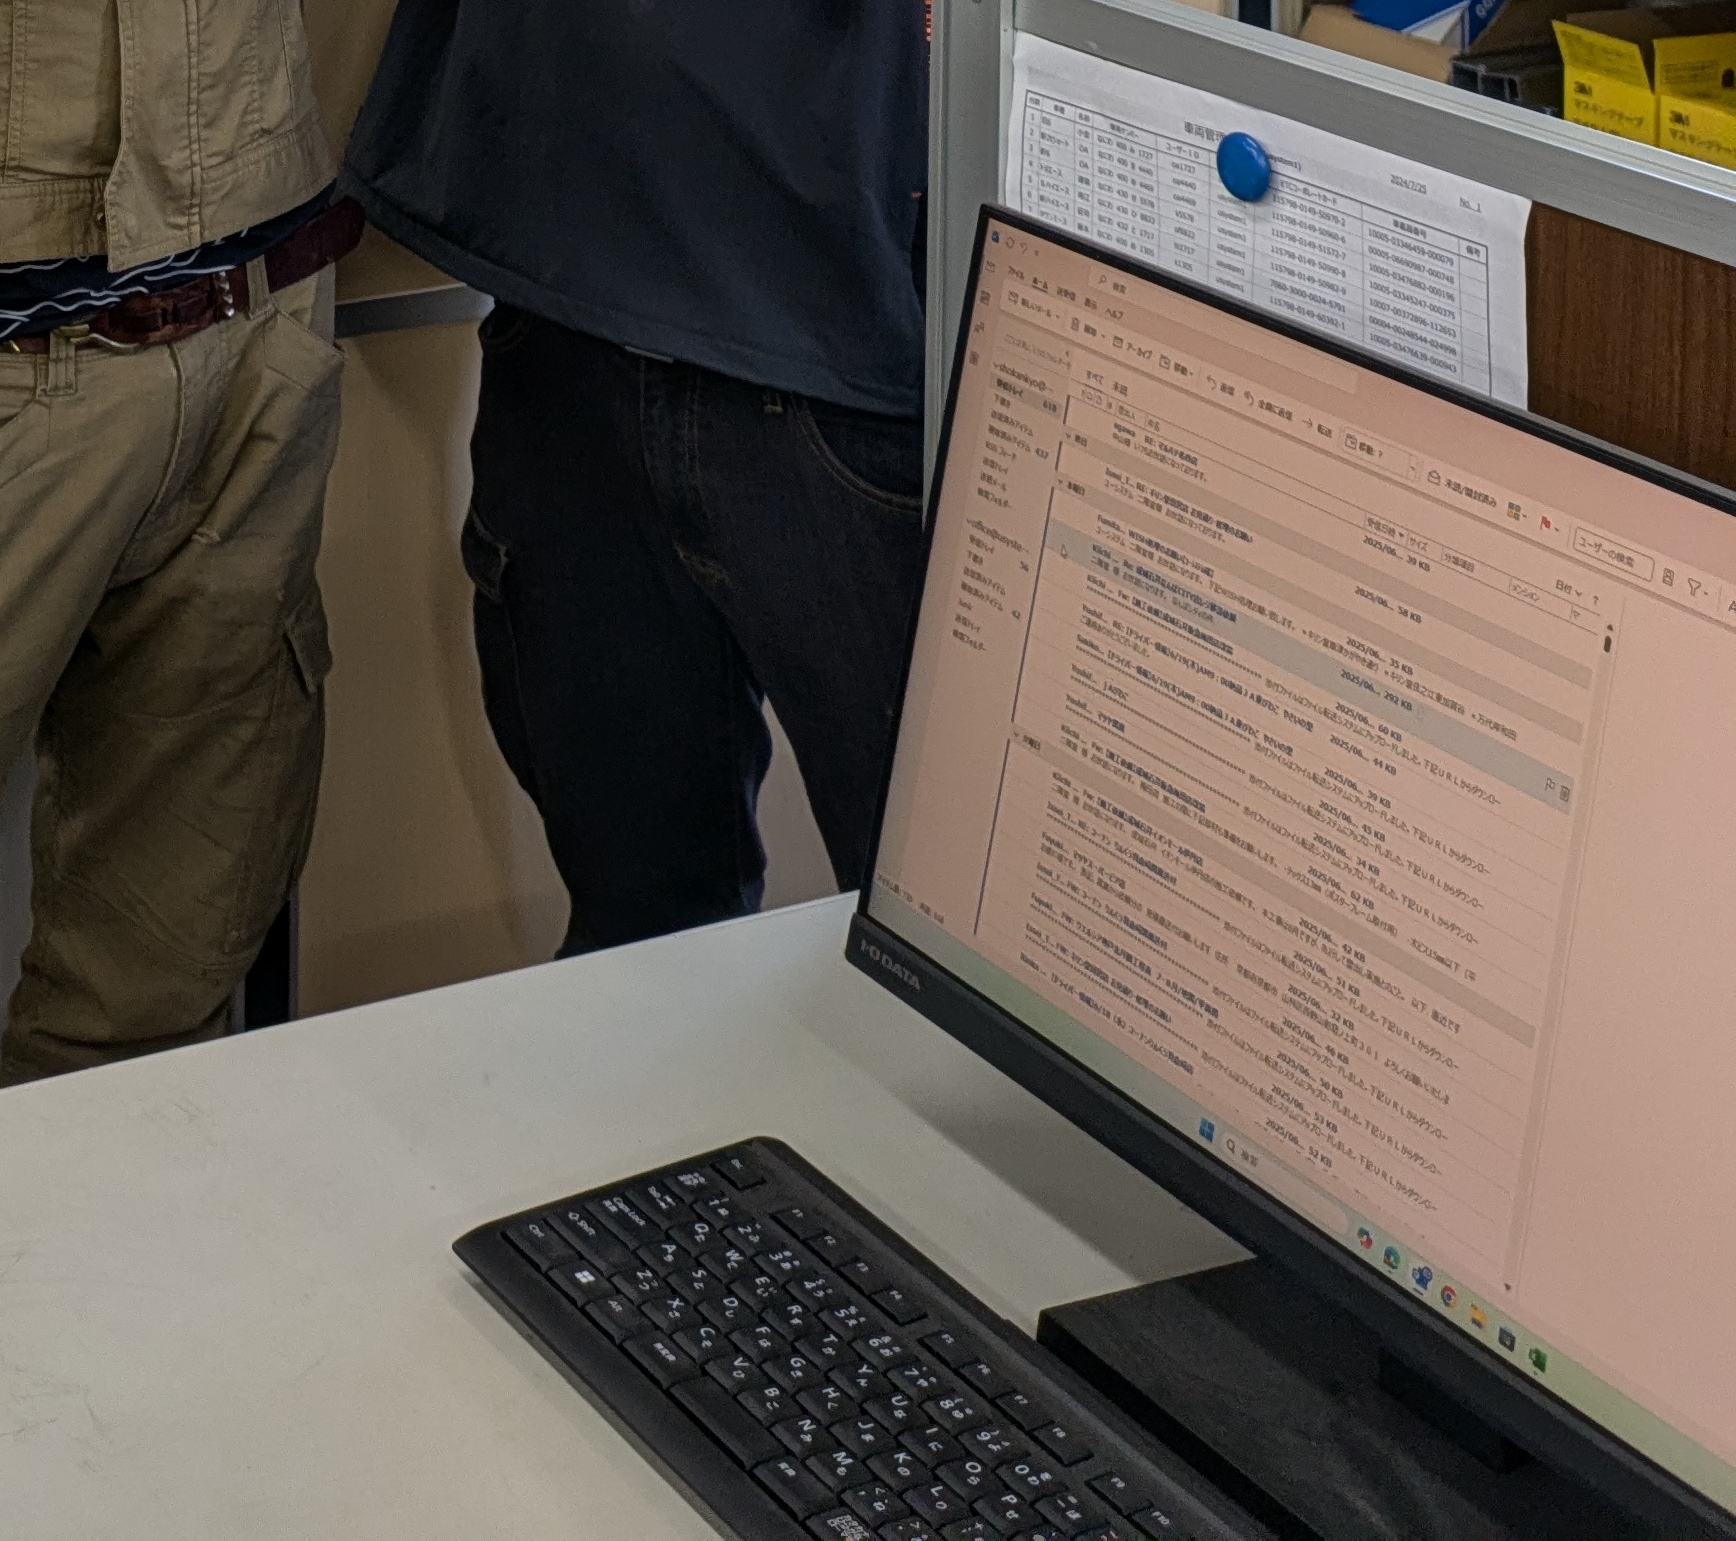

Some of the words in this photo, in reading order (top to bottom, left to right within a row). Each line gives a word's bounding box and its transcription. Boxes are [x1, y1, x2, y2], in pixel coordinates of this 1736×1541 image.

[1105, 305, 1123, 322] ヘルプ
[1408, 535, 1428, 554] サイズ
[1578, 536, 1635, 569] ユーザーの検索
[1405, 553, 1416, 568] 39
[1417, 558, 1430, 574] KB
[1554, 578, 1573, 596] 日付
[1409, 610, 1422, 625] KB
[1400, 661, 1414, 677] KB
[1383, 689, 1399, 706] 292
[1399, 697, 1413, 713] KB
[1377, 721, 1389, 737] 60
[1390, 728, 1403, 744] KB
[1371, 755, 1383, 771] 44
[1384, 761, 1397, 778] KB
[1373, 828, 1386, 845] KB
[661, 1242, 677, 1255] A
[725, 1249, 744, 1264] W
[636, 1269, 653, 1280] Z
[691, 1268, 707, 1279] S
[755, 1276, 771, 1288] E
[667, 1298, 684, 1310] X
[722, 1298, 739, 1308] D
[787, 1304, 802, 1315] R
[699, 1327, 716, 1337] C
[755, 1326, 771, 1337] F
[823, 1334, 839, 1345] T
[733, 1356, 749, 1368] V
[790, 1357, 806, 1368] G
[857, 1364, 873, 1375] Y
[763, 1387, 780, 1397] B
[822, 1387, 840, 1399] H
[891, 1395, 908, 1406] U
[798, 1419, 817, 1432] N
[858, 1420, 874, 1429] J
[833, 1451, 854, 1466] M
[893, 1452, 912, 1464] K
[930, 1486, 945, 1497] L
[1000, 1494, 1018, 1505] P
